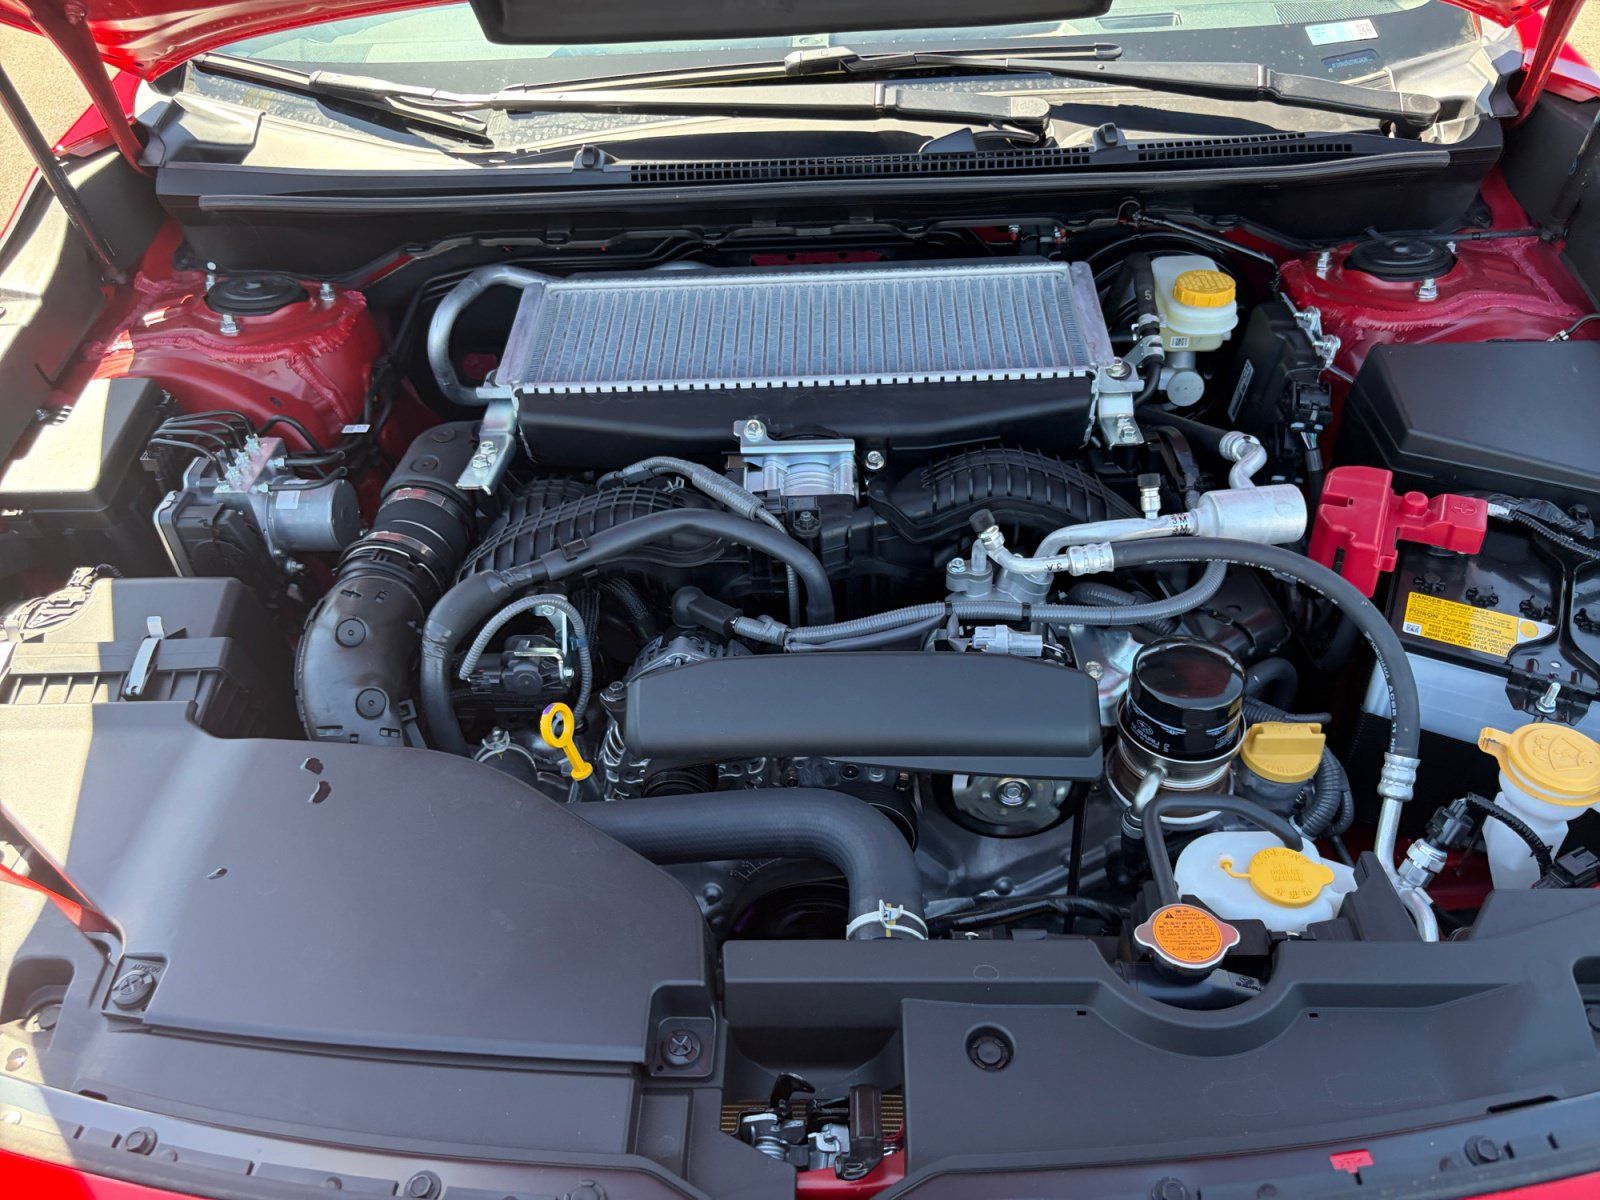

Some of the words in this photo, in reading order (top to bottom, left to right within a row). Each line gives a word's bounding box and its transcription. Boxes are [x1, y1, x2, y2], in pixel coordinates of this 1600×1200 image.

[1144, 290, 1152, 300] 5
[1411, 594, 1442, 604] DANGER
[1409, 608, 1438, 620] POISON
